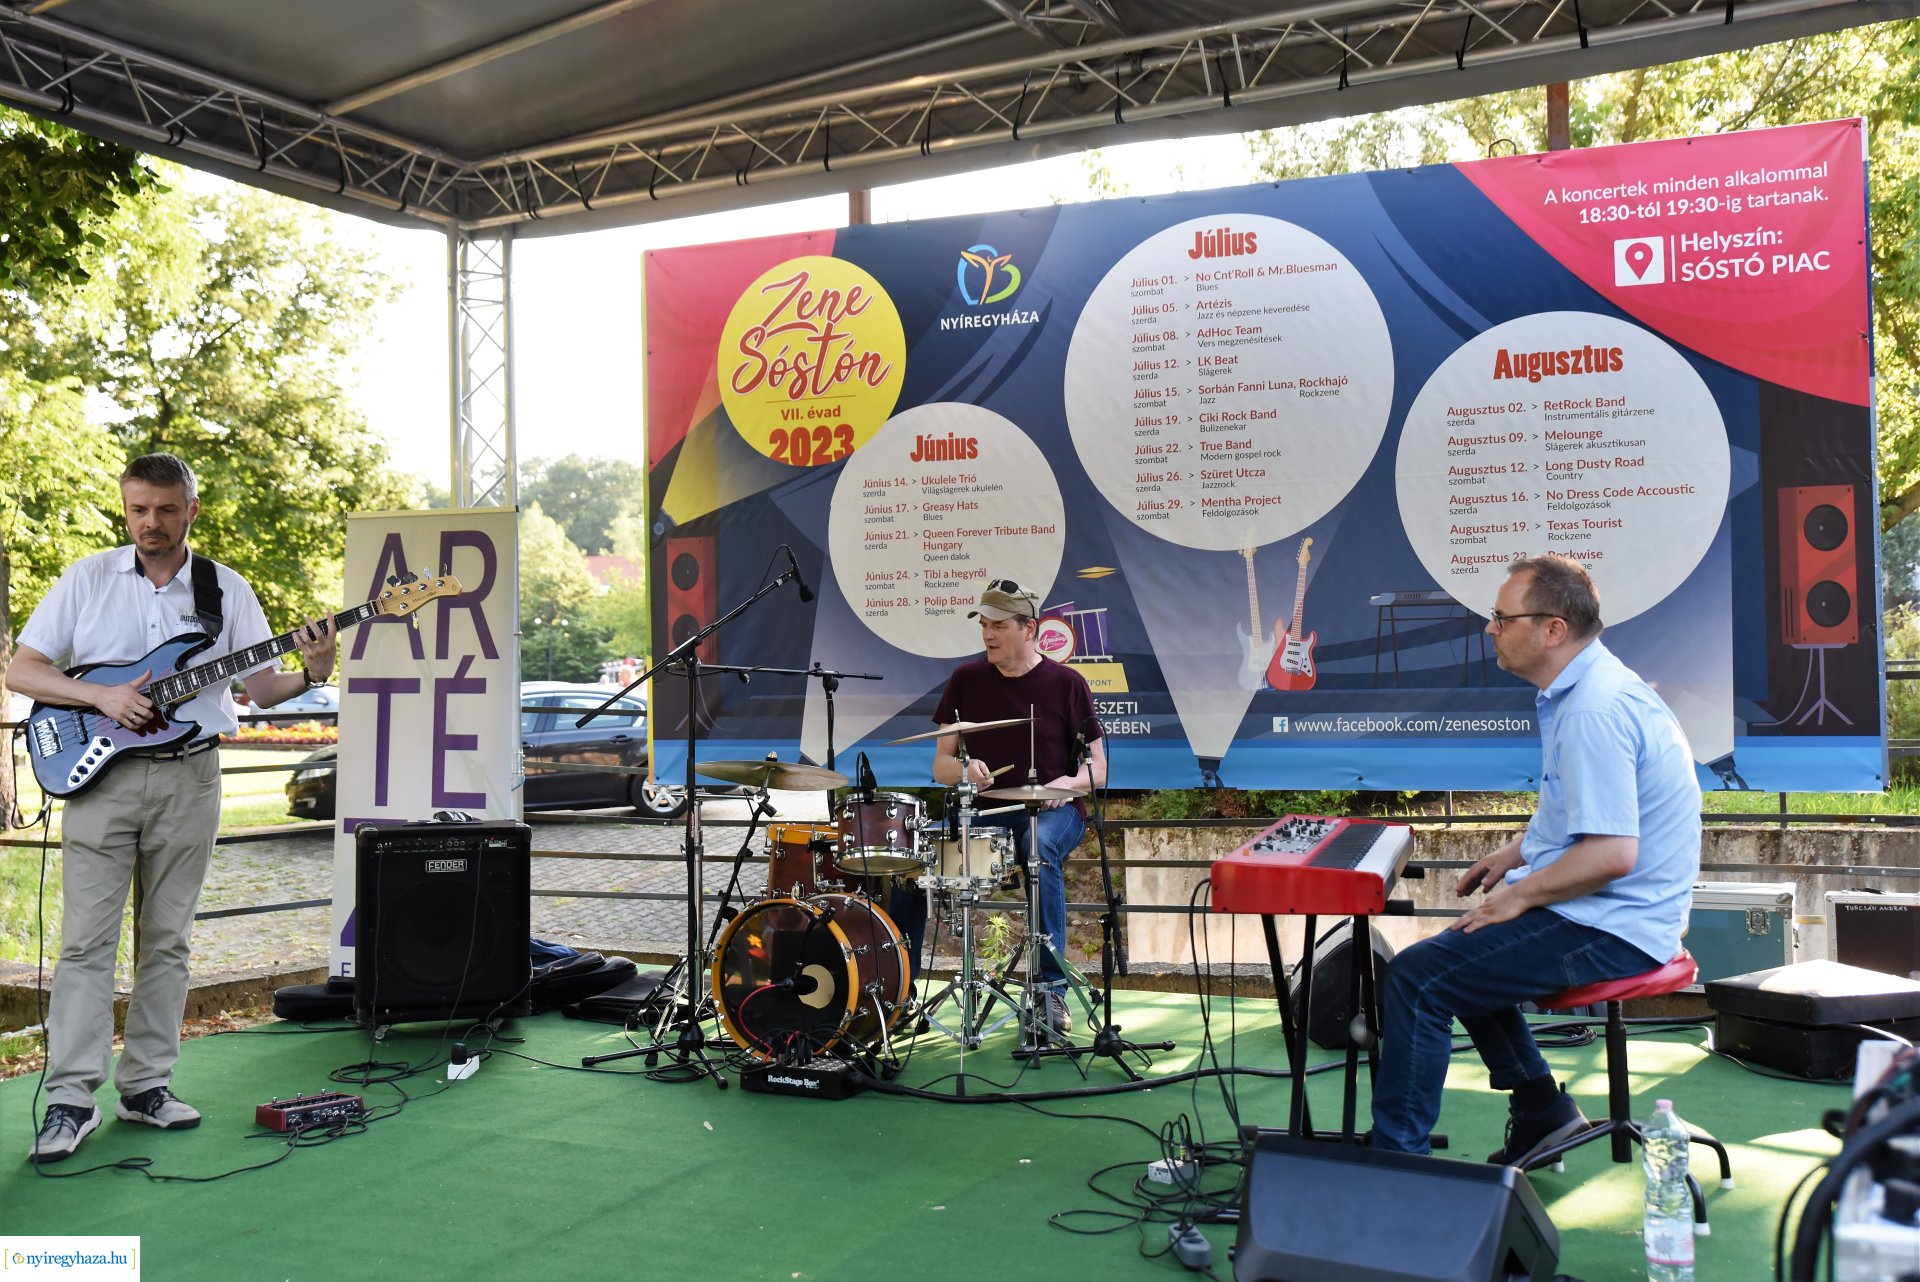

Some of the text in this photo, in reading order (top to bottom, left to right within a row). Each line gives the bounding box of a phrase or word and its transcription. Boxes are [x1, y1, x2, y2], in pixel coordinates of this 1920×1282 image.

[1544, 161, 1828, 205] A koncertek minden alkalommal
[1579, 186, 1829, 224] 18:30-tól 19:30-ig tartanak.
[1188, 227, 1257, 259] Július
[1681, 227, 1783, 253] Helyszín:
[1681, 251, 1831, 282] SÓSTÓ PIAC
[1131, 277, 1159, 288] Július
[1161, 275, 1177, 285] 01.
[1196, 272, 1211, 282] No
[1257, 267, 1265, 277] &
[1268, 262, 1338, 276] Mr.Bluesman
[1196, 284, 1218, 292] Blues
[760, 271, 874, 335] Zene
[1131, 299, 1232, 315] Július 05. Artézis
[1197, 304, 1310, 320] Jazz és népzene keveredése
[940, 310, 1039, 331] NYÍREGYHÁZA
[1132, 325, 1262, 343] Július 08. AdHoc Team
[1198, 335, 1282, 348] Vers megzenésítések
[731, 321, 895, 401] Sóstón
[1133, 355, 1238, 371] Július 12. LK Beat
[1493, 345, 1623, 383] Augusztus
[1198, 367, 1232, 377] Slágerek
[1133, 376, 1348, 399] Július 15. Sorbán Fanni Luna, Rockhajó
[1300, 389, 1340, 398] Rockzene
[1200, 396, 1216, 405] Jazz
[1447, 396, 1625, 419] Augusztus 02. RetRock Band
[781, 406, 841, 420] VII. évad
[1134, 409, 1277, 427] Július 19. Ciki Rock Band
[1544, 407, 1655, 421] Instrumentális gitárzene
[1200, 423, 1247, 432] Bulizenekar
[769, 424, 856, 466] 2023
[1448, 430, 1603, 448] Augusztus 09. Melounge
[1545, 438, 1646, 452] Slágerek akusztikusan
[910, 432, 978, 462] Június
[1135, 439, 1252, 455] Július 22. True Band
[1201, 449, 1281, 461] Modern gospel rock
[1448, 457, 1644, 478] Augusztus 12. Long Dusty Road
[863, 474, 977, 488] Június 14. Ukulele Trió
[1136, 468, 1266, 483] Július 26. Szüret Utcza
[1449, 477, 1486, 486] szombat
[1546, 471, 1583, 482] Country
[922, 484, 1003, 495] Világslágerek ukulelén
[1201, 481, 1235, 489] Jazzrock
[1449, 484, 1695, 506] Augusztus 16. No Dress Code Accoustic
[864, 501, 978, 515] Június 17. Greasy Hats
[1137, 495, 1281, 511] Július 29. Mentha Project
[1547, 501, 1611, 511] Feldolgozások
[1202, 508, 1259, 518] Feldolgozások
[864, 524, 1055, 541] Június 21. Queen Forever Tribute Band
[1450, 518, 1623, 536] Augusztus 19. Texas Tourist
[1548, 532, 1592, 541] Rockzene
[923, 541, 963, 552] Hungary
[924, 554, 948, 562] Queen
[1451, 553, 1509, 566] Augusztus
[865, 571, 894, 581] Június
[896, 571, 910, 580] 24.
[924, 569, 941, 579] Tibi
[952, 568, 987, 579] hegyről
[1451, 567, 1479, 575] szerda
[865, 596, 974, 608] Június 28. Polip Band
[924, 608, 955, 616] Slágerek
[1294, 716, 1531, 733] www.facebook.com/zenesoston
[428, 860, 464, 871] FENDER
[767, 1074, 803, 1086] RockStage
